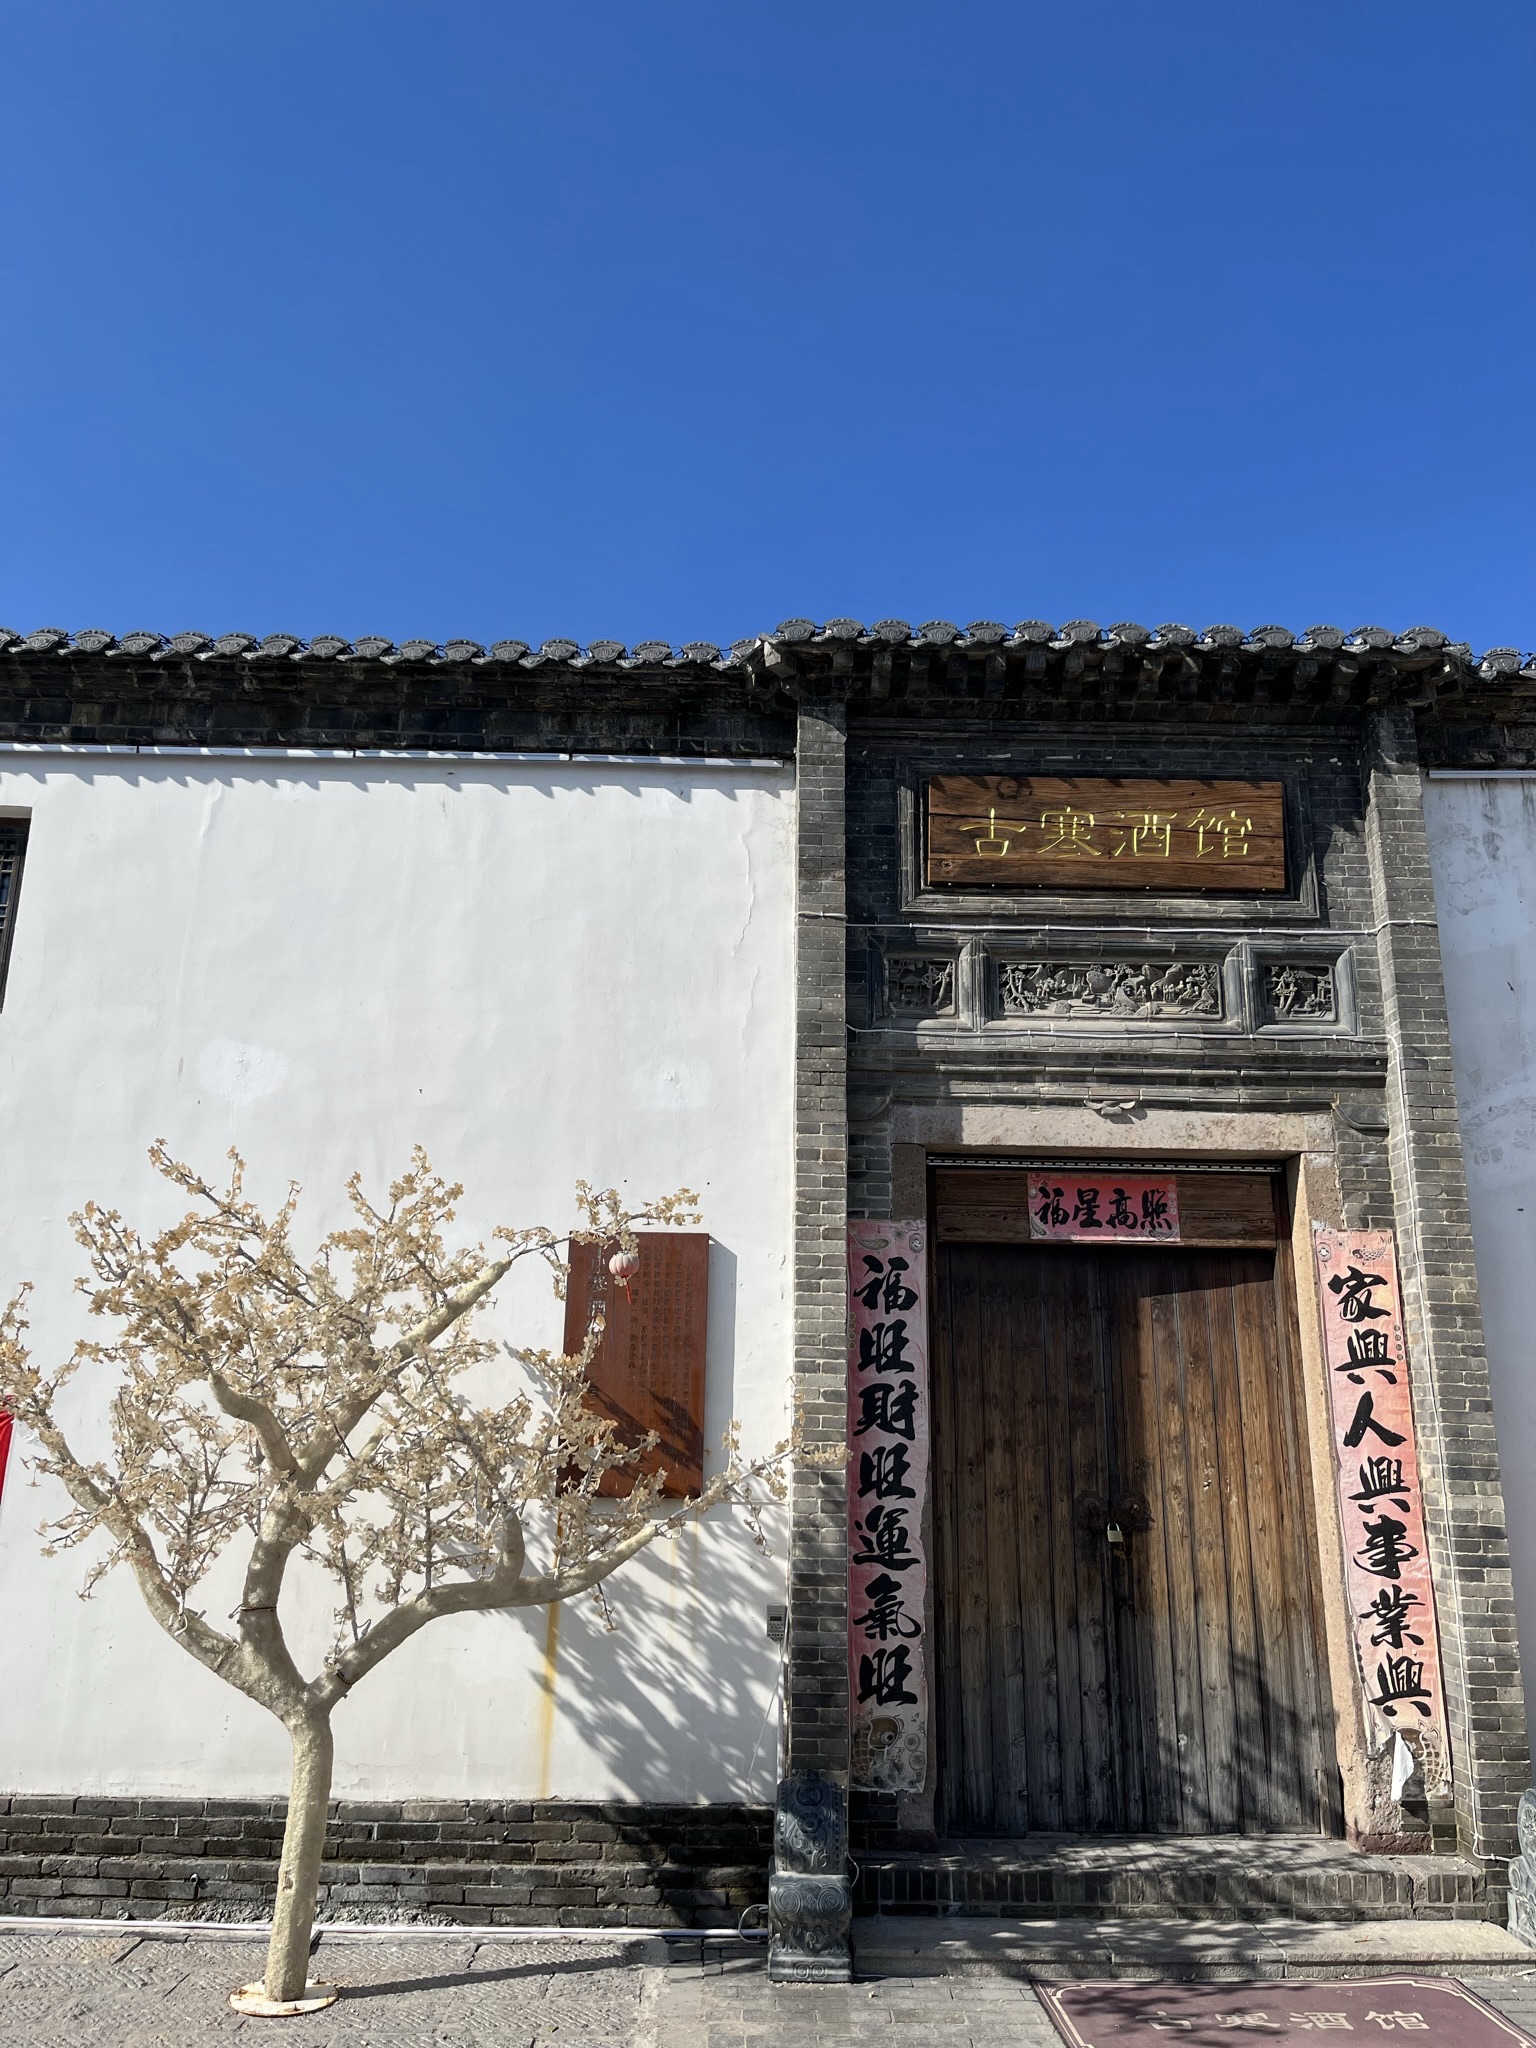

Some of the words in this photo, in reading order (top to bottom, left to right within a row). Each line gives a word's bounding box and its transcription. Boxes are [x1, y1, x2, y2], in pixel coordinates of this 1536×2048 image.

[959, 806, 1252, 858] 古寒酒馆
[1034, 1187, 1172, 1231] 福星高照
[853, 1256, 921, 1707] 福旺財旺運氣旺
[1327, 1265, 1433, 1718] 家興人興事業興
